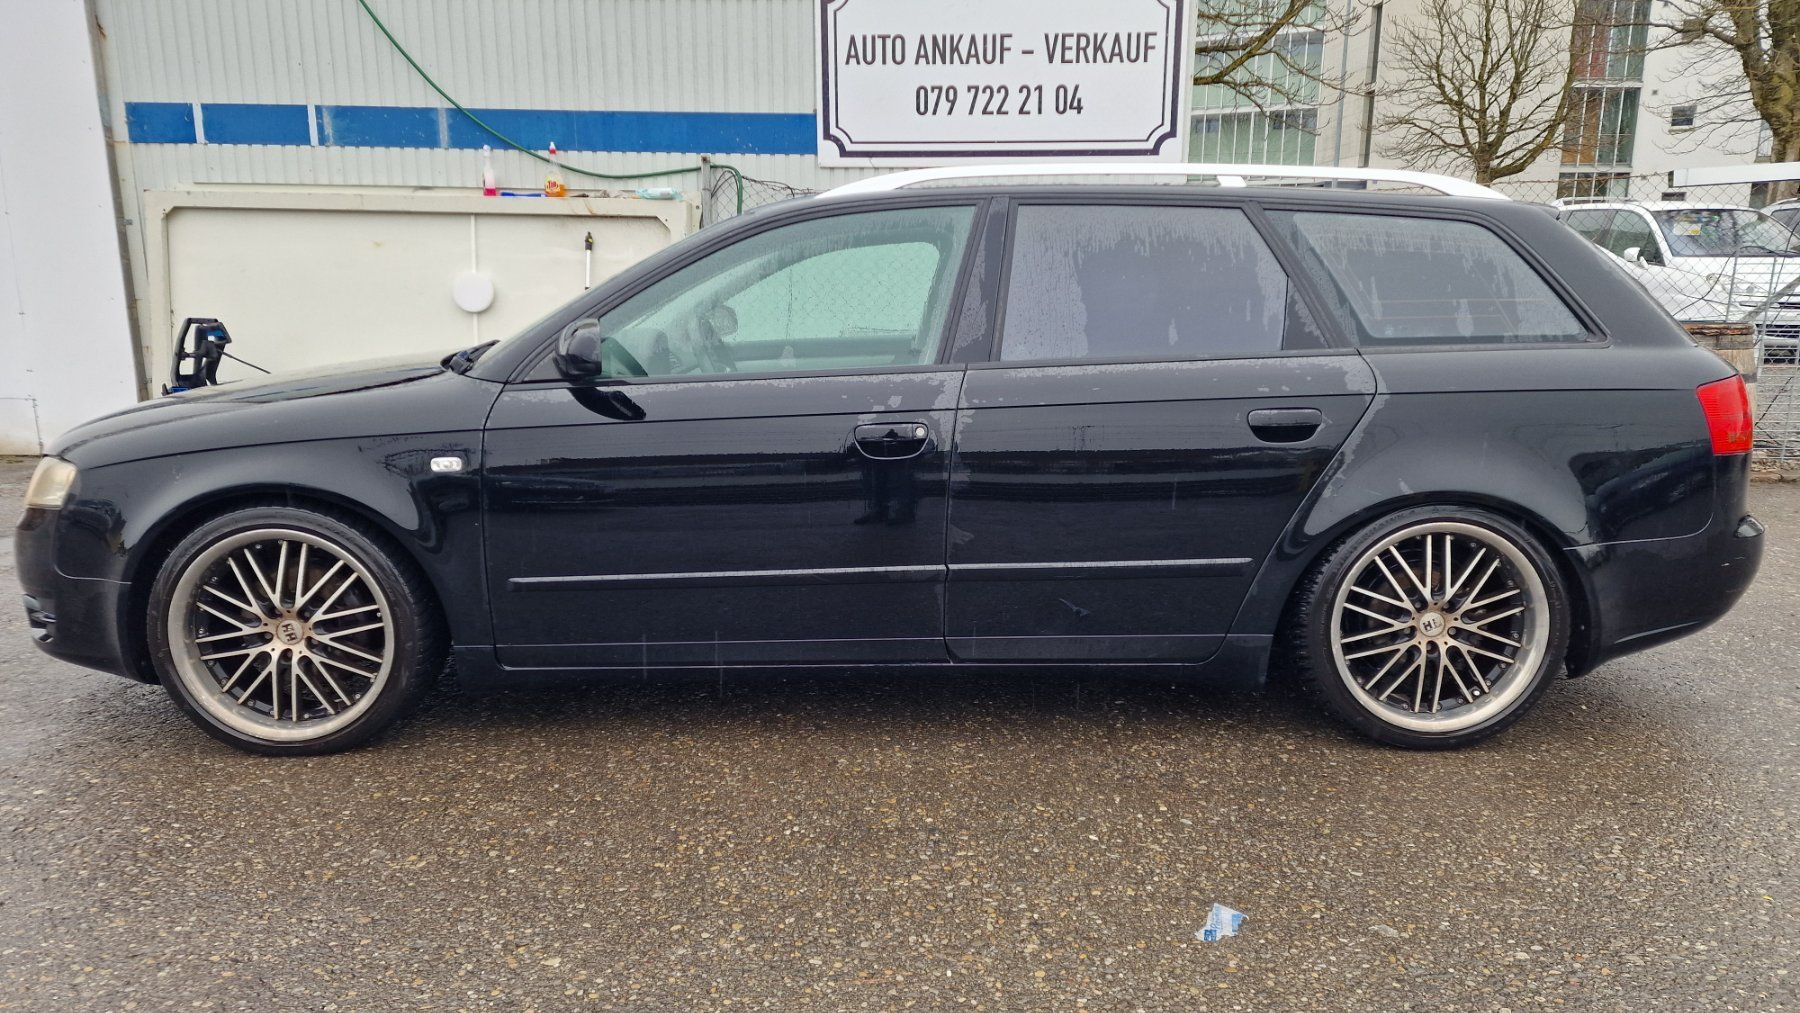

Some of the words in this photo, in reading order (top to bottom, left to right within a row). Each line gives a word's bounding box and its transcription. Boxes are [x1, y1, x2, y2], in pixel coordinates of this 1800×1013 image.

[845, 33, 906, 66] AUTO
[914, 33, 1013, 66] ANKAUF
[1044, 32, 1158, 64] VERKAUF
[915, 84, 958, 116] 079
[967, 84, 1010, 116] 722
[1018, 84, 1043, 115] 21
[1054, 84, 1084, 115] 04
